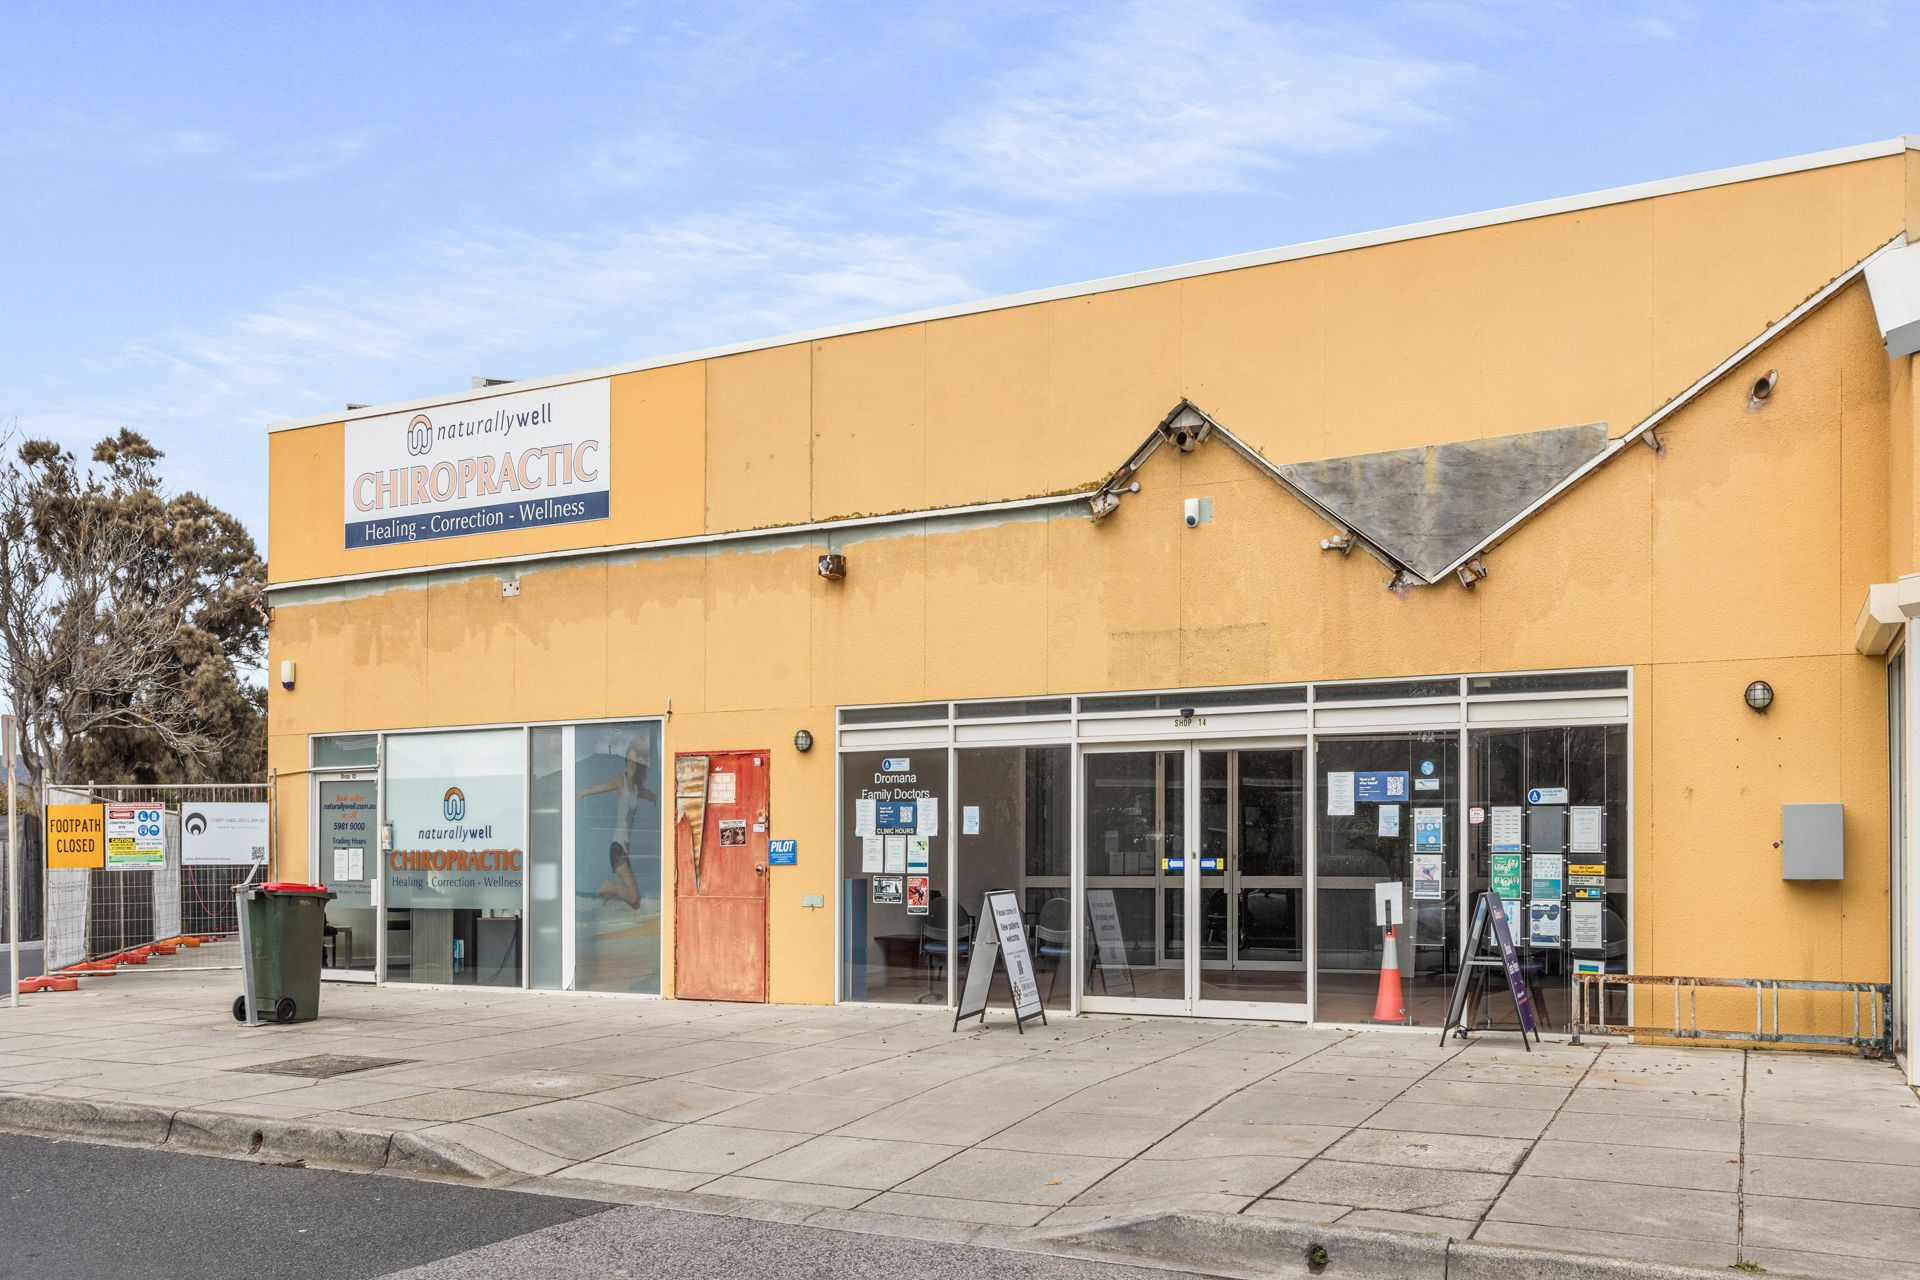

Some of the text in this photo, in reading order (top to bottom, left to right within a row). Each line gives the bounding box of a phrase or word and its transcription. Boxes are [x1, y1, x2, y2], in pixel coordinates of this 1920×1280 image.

[437, 402, 551, 440] naturallywell
[353, 439, 599, 512] CHIROPRACTIC
[365, 520, 416, 541] Healing
[430, 509, 504, 533] Correction
[519, 499, 585, 522] Wellness
[1174, 718, 1207, 727] SHOP 14
[874, 772, 917, 784] Dromana
[862, 788, 930, 802] Family Doctors
[50, 819, 101, 833] FOOTPATH
[418, 825, 492, 843] naturallywell
[57, 838, 95, 853] CLOSED
[332, 837, 350, 846] Trading
[770, 841, 794, 852] PILOT
[389, 848, 522, 872] CHIROPRACTIC
[392, 877, 423, 889] Healing
[431, 876, 475, 888] Correction
[484, 876, 522, 888] Wellness
[1000, 923, 1008, 931] New
